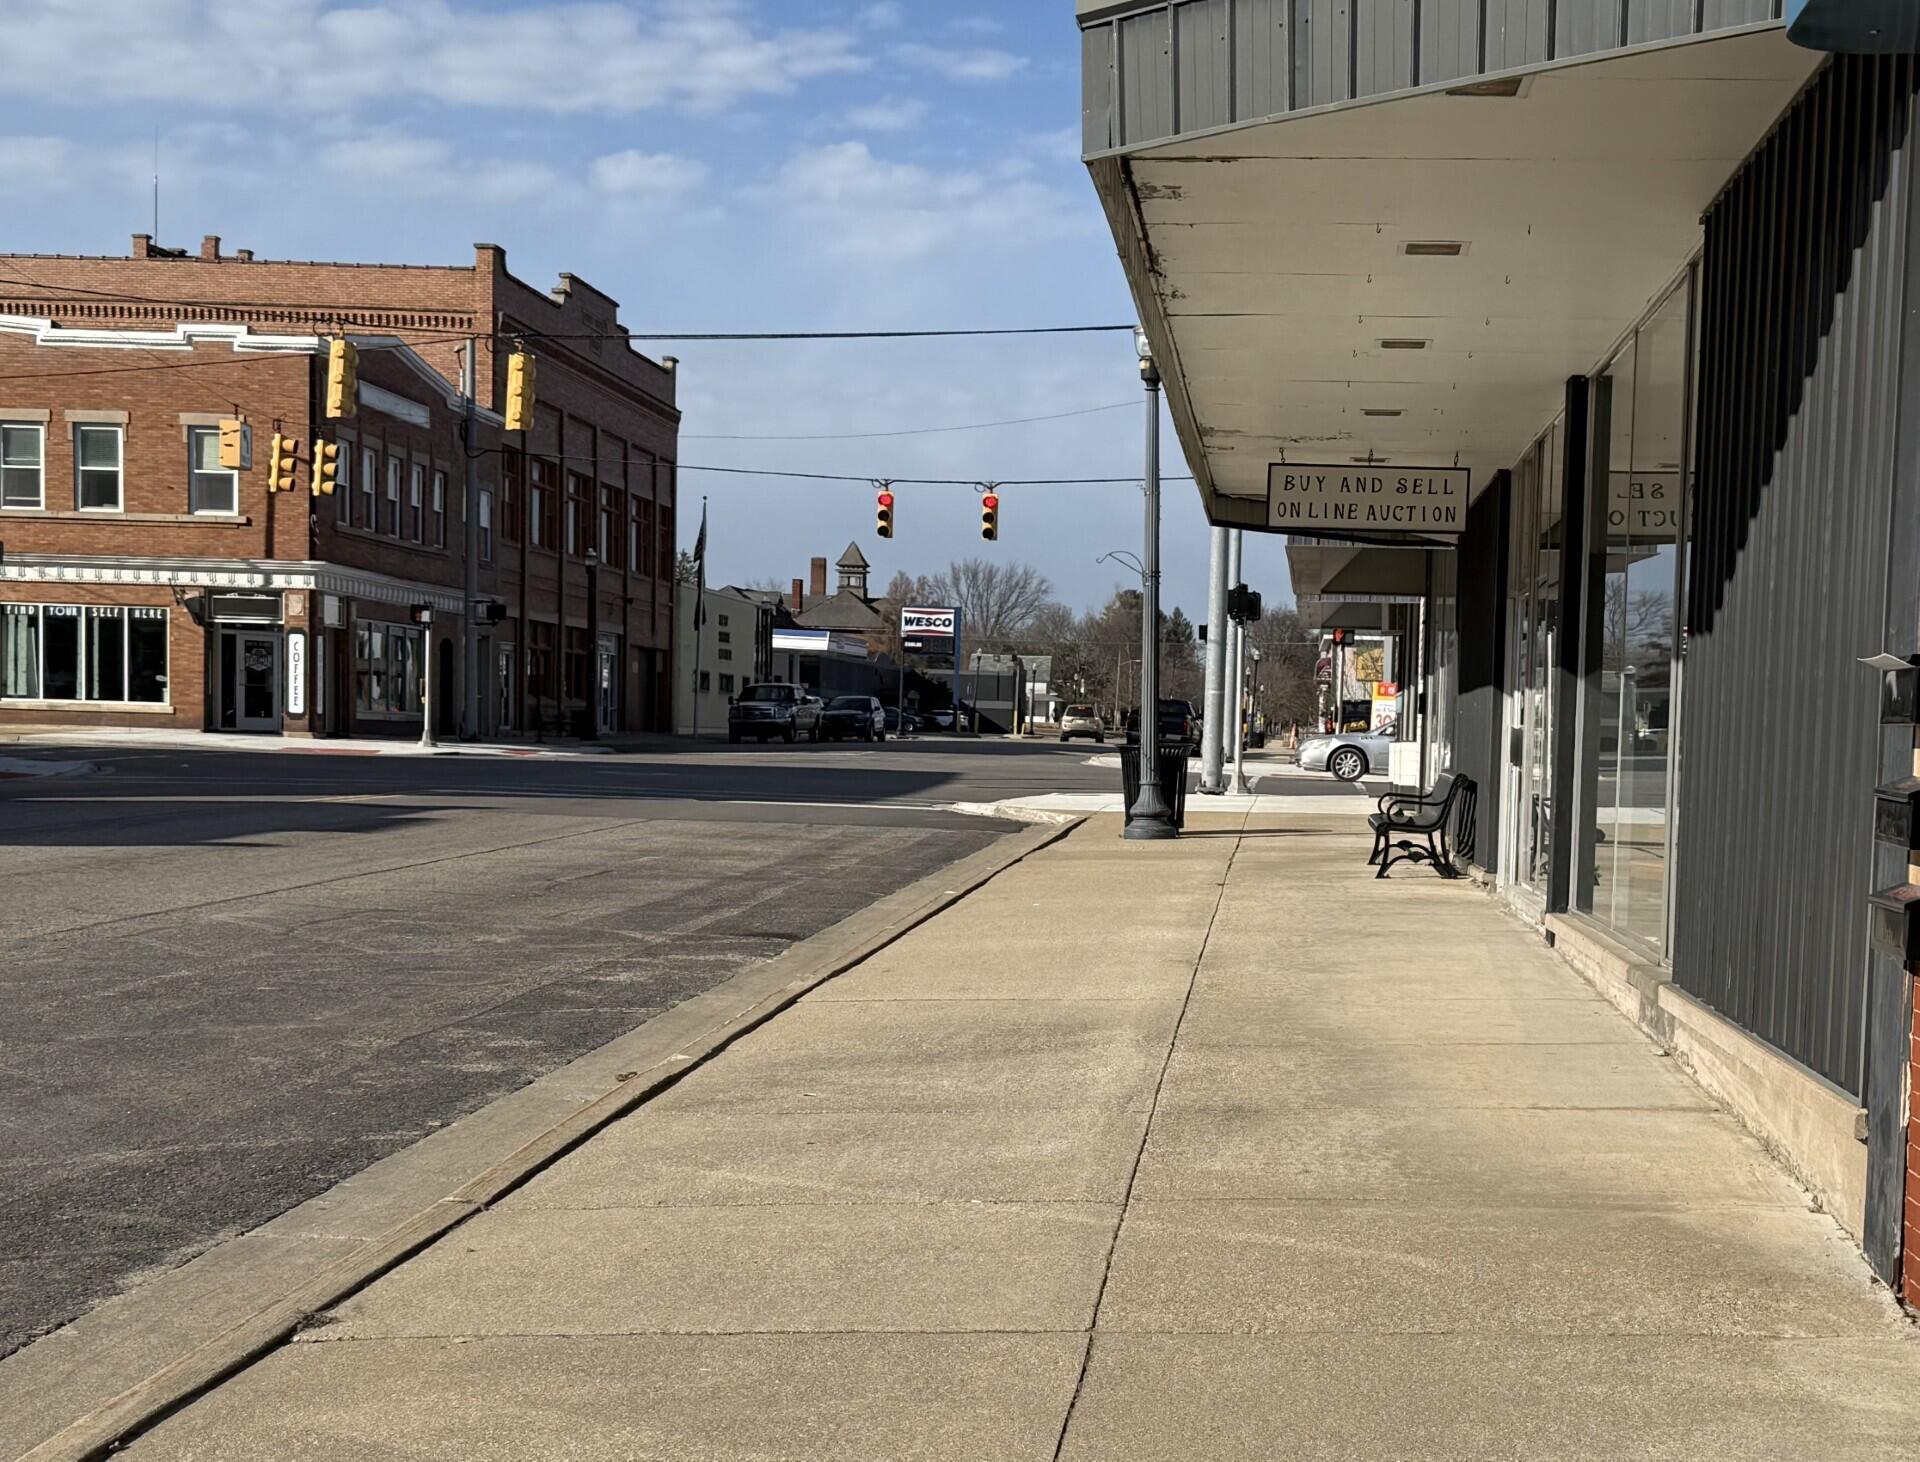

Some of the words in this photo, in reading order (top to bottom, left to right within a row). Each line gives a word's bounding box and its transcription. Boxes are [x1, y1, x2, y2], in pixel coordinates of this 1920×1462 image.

[1283, 474, 1327, 492] BUY
[1340, 476, 1383, 493] AND
[1396, 477, 1454, 495] SELL
[1366, 504, 1457, 523] AUCTION
[7, 605, 35, 615] FIND
[49, 606, 78, 616] YOUR
[92, 608, 119, 618] SELF
[134, 609, 162, 619] HERE
[904, 616, 952, 627] WESCO
[293, 641, 301, 706] COFFEE
